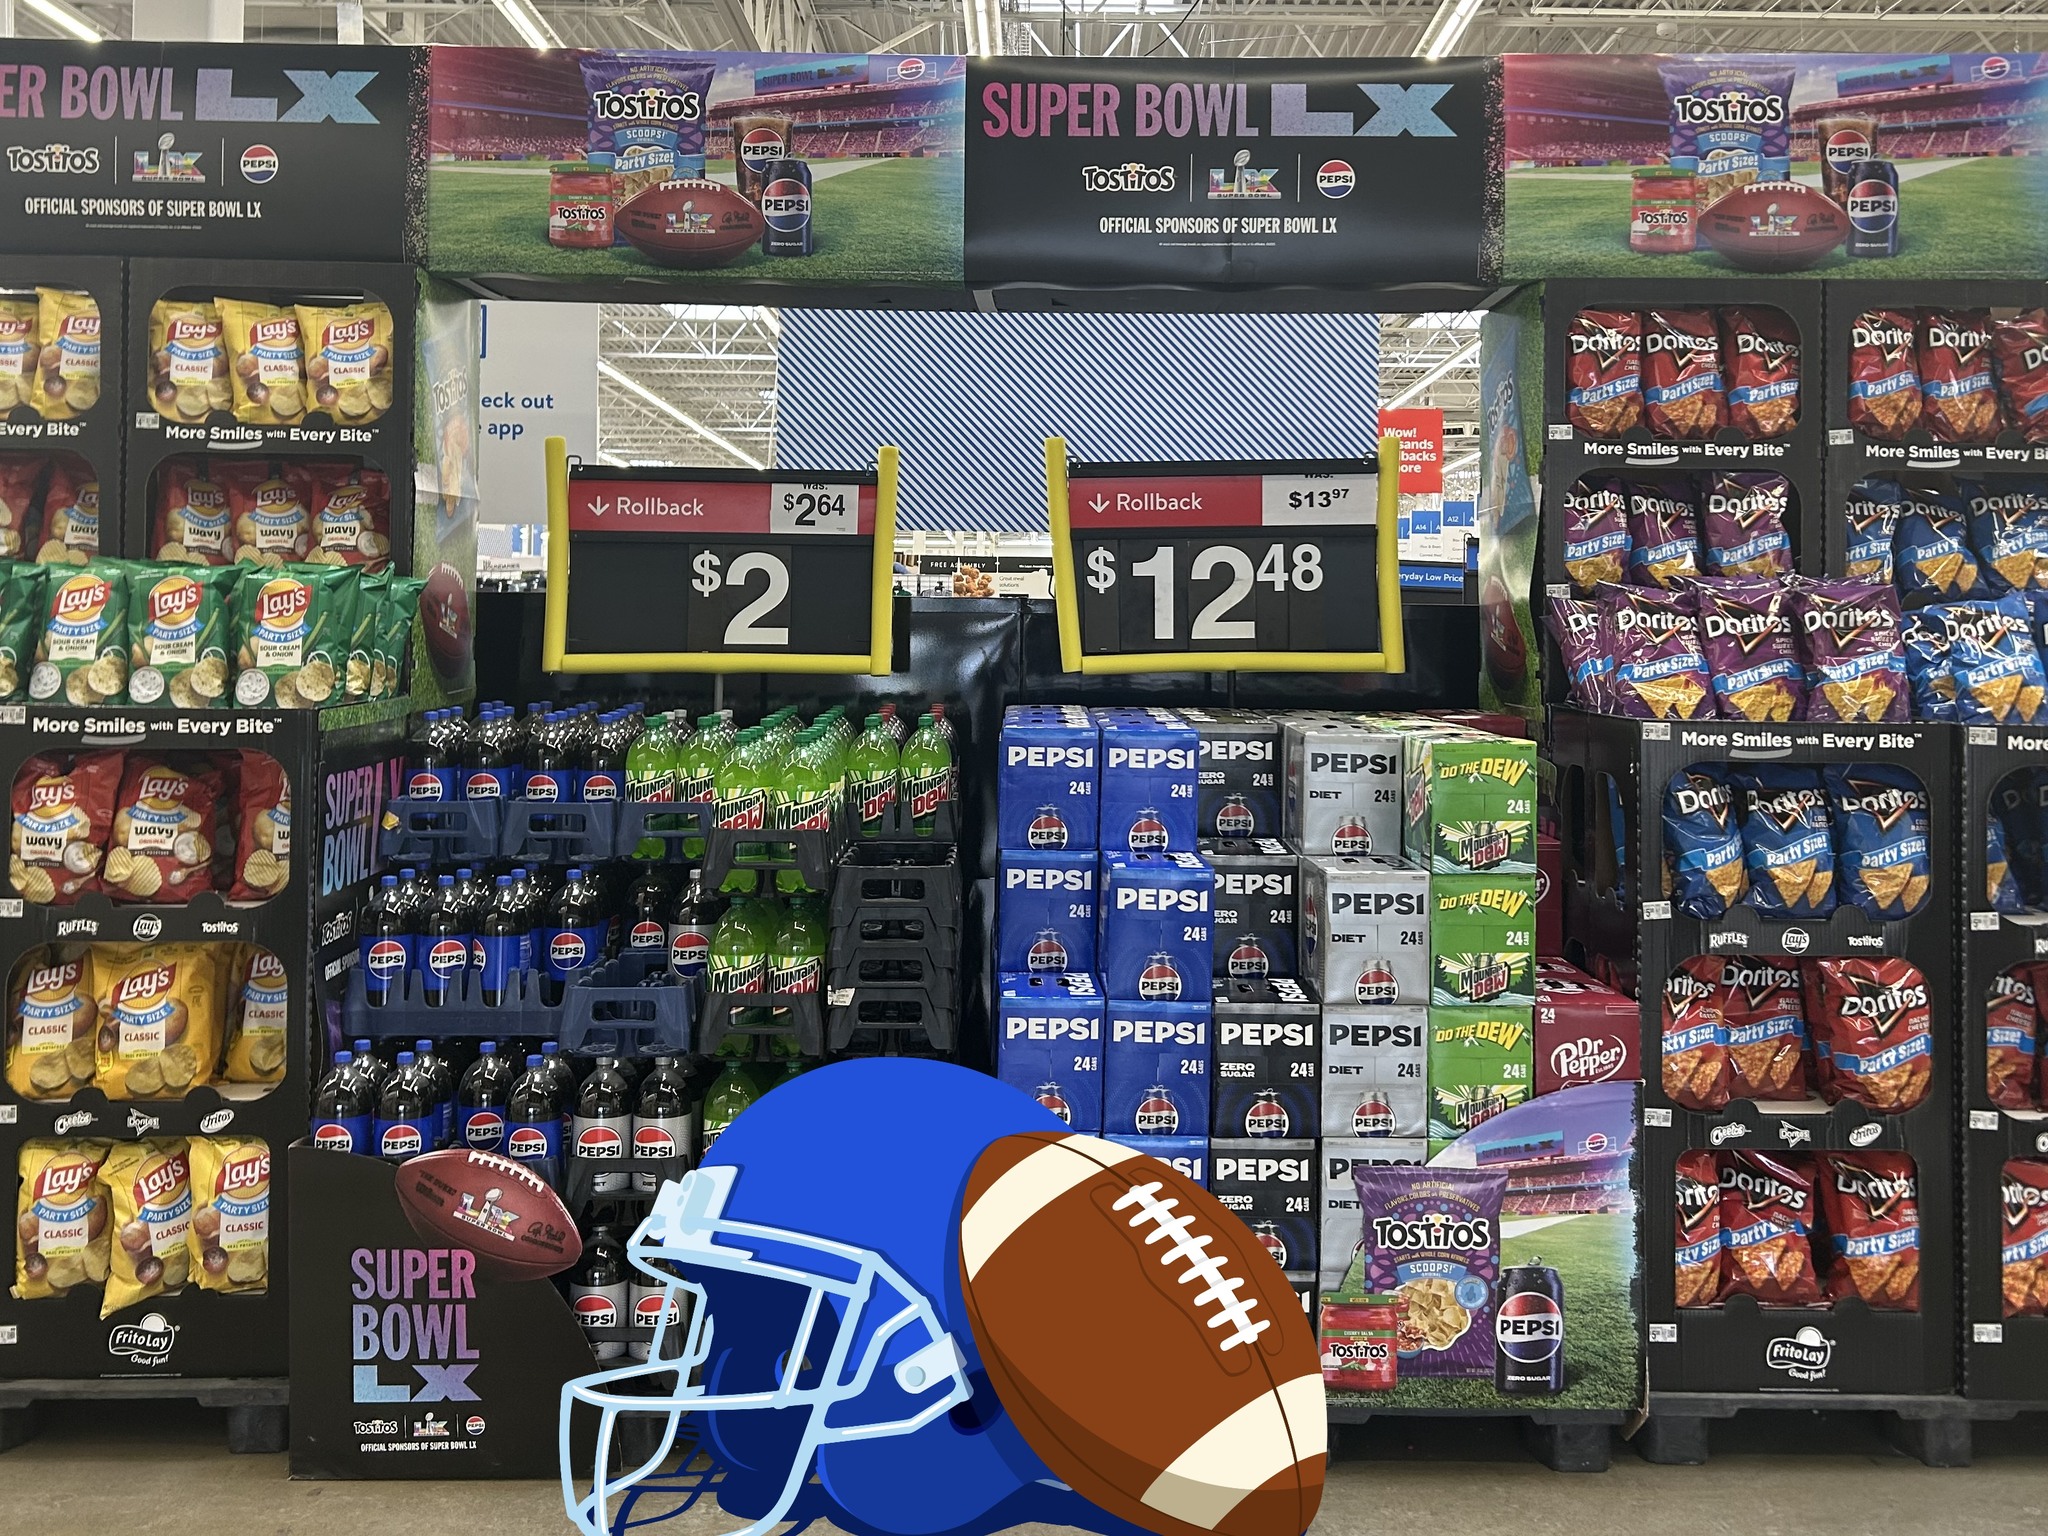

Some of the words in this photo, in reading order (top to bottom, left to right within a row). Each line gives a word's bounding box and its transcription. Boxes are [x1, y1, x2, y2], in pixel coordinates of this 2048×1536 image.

[61, 66, 184, 121] BOWL
[195, 68, 381, 124] LX
[982, 82, 1120, 138] SUPER
[1136, 83, 1259, 137] BOWL
[1271, 83, 1458, 137] LX
[626, 130, 666, 138] SCOOPS!
[1709, 134, 1750, 142] SCOOPS!
[614, 155, 646, 170] Party
[649, 152, 674, 166] Size!
[1698, 159, 1730, 173] Party
[1732, 155, 1758, 168] Size!
[25, 197, 77, 215] OFFICIAL
[81, 198, 144, 217] SPONSORS
[148, 200, 163, 216] OF
[167, 201, 205, 217] SUPER
[208, 201, 244, 217] BOWL
[247, 202, 261, 218] LX
[765, 199, 808, 211] PEPSI
[1851, 200, 1896, 212] PEPSI
[1100, 217, 1152, 233] OFFICIAL
[1156, 217, 1219, 234] SPONSORS
[1223, 218, 1238, 233] OF
[1242, 218, 1281, 233] SUPER
[1284, 218, 1318, 233] BOWL
[1322, 218, 1337, 233] LX
[333, 366, 365, 374] CLASSIC
[482, 393, 514, 409] eck
[521, 394, 553, 409] out
[166, 426, 205, 440] More
[210, 427, 262, 440] Smiles
[266, 430, 286, 438] with
[290, 428, 335, 443] Every
[488, 421, 523, 440] app
[1383, 428, 1417, 438] Wow!
[1584, 443, 1624, 455] More
[1627, 444, 1678, 455] Smiles
[1682, 446, 1701, 454] with
[1705, 445, 1748, 458] Every
[1866, 446, 1905, 458] More
[1909, 447, 1960, 458] Smiles
[1964, 448, 1983, 457] with
[1986, 447, 2030, 461] Every
[617, 497, 703, 517] Rollback
[1117, 492, 1202, 511] Rollback
[260, 527, 293, 541] wavy
[1426, 573, 1441, 581] Low
[692, 550, 790, 644] $2
[1705, 614, 1791, 638] Doritos
[1805, 608, 1894, 632] Doritos
[33, 717, 79, 734] More
[84, 719, 145, 733] Smiles
[150, 721, 173, 731] with
[177, 720, 230, 735] Every
[1682, 732, 1728, 747] More
[1732, 733, 1792, 747] Smiles
[1797, 735, 1819, 745] with
[1823, 733, 1874, 751] Every
[1008, 746, 1093, 767] PEPSI
[1109, 748, 1194, 769] PEPSI
[1253, 774, 1267, 786] 24
[1440, 766, 1458, 778] DO
[1460, 761, 1480, 775] THE
[1481, 758, 1529, 787] DEW
[324, 762, 373, 830] SUPER
[1310, 791, 1341, 799] DIET
[1375, 790, 1390, 802] 24
[134, 826, 174, 838] wavy
[26, 836, 62, 849] wavy
[323, 823, 369, 896] BOWL
[1006, 869, 1091, 890] PEPSI
[1117, 887, 1208, 911] PEPSI
[57, 919, 98, 936] RUFFLES
[202, 922, 239, 932] Tostitos
[1183, 927, 1200, 941] 24
[1332, 934, 1366, 943] DIET
[1710, 933, 1748, 948] RUFFLES
[1848, 935, 1883, 947] Tostitos
[121, 969, 170, 1000] Lay's
[1841, 984, 1927, 1017] Doritos
[1541, 1008, 1555, 1019] 24
[28, 1024, 67, 1034] CLASSIC
[124, 1032, 159, 1041] CLASSIC
[1577, 1038, 1603, 1057] Dr
[1551, 1043, 1620, 1078] Pepper
[1329, 1066, 1363, 1074] DIET
[56, 1112, 92, 1133] Cheetos
[203, 1110, 231, 1126] Fritos
[42, 1163, 92, 1196] Lay's
[139, 1160, 185, 1200] Lay's
[1412, 1182, 1421, 1190] NO
[1422, 1181, 1455, 1191] ARTIFICIAL
[1219, 1196, 1253, 1204] ZERO
[1286, 1197, 1303, 1212] 24
[1409, 1191, 1430, 1200] COLORS
[1439, 1191, 1480, 1212] PRESERVATIVES
[38, 1208, 69, 1221] PARTY
[70, 1204, 89, 1219] SIZE
[44, 1228, 83, 1238] CLASSIC
[226, 1221, 264, 1232] CLASSIC
[351, 1248, 476, 1300] SUPER
[1410, 1263, 1453, 1273] SCOOPS!
[353, 1304, 479, 1360] BOWL
[1500, 1320, 1560, 1336] PEPSI
[131, 1354, 152, 1364] Good
[152, 1354, 169, 1367] fun!
[1789, 1369, 1808, 1378] Good
[354, 1364, 482, 1403] LX
[361, 1442, 386, 1452] OFFICIAL
[388, 1442, 419, 1451] SPONSORS
[421, 1442, 428, 1451] OF
[430, 1441, 449, 1450] SUPER
[451, 1441, 467, 1450] BOWL
[469, 1441, 476, 1449] LX
